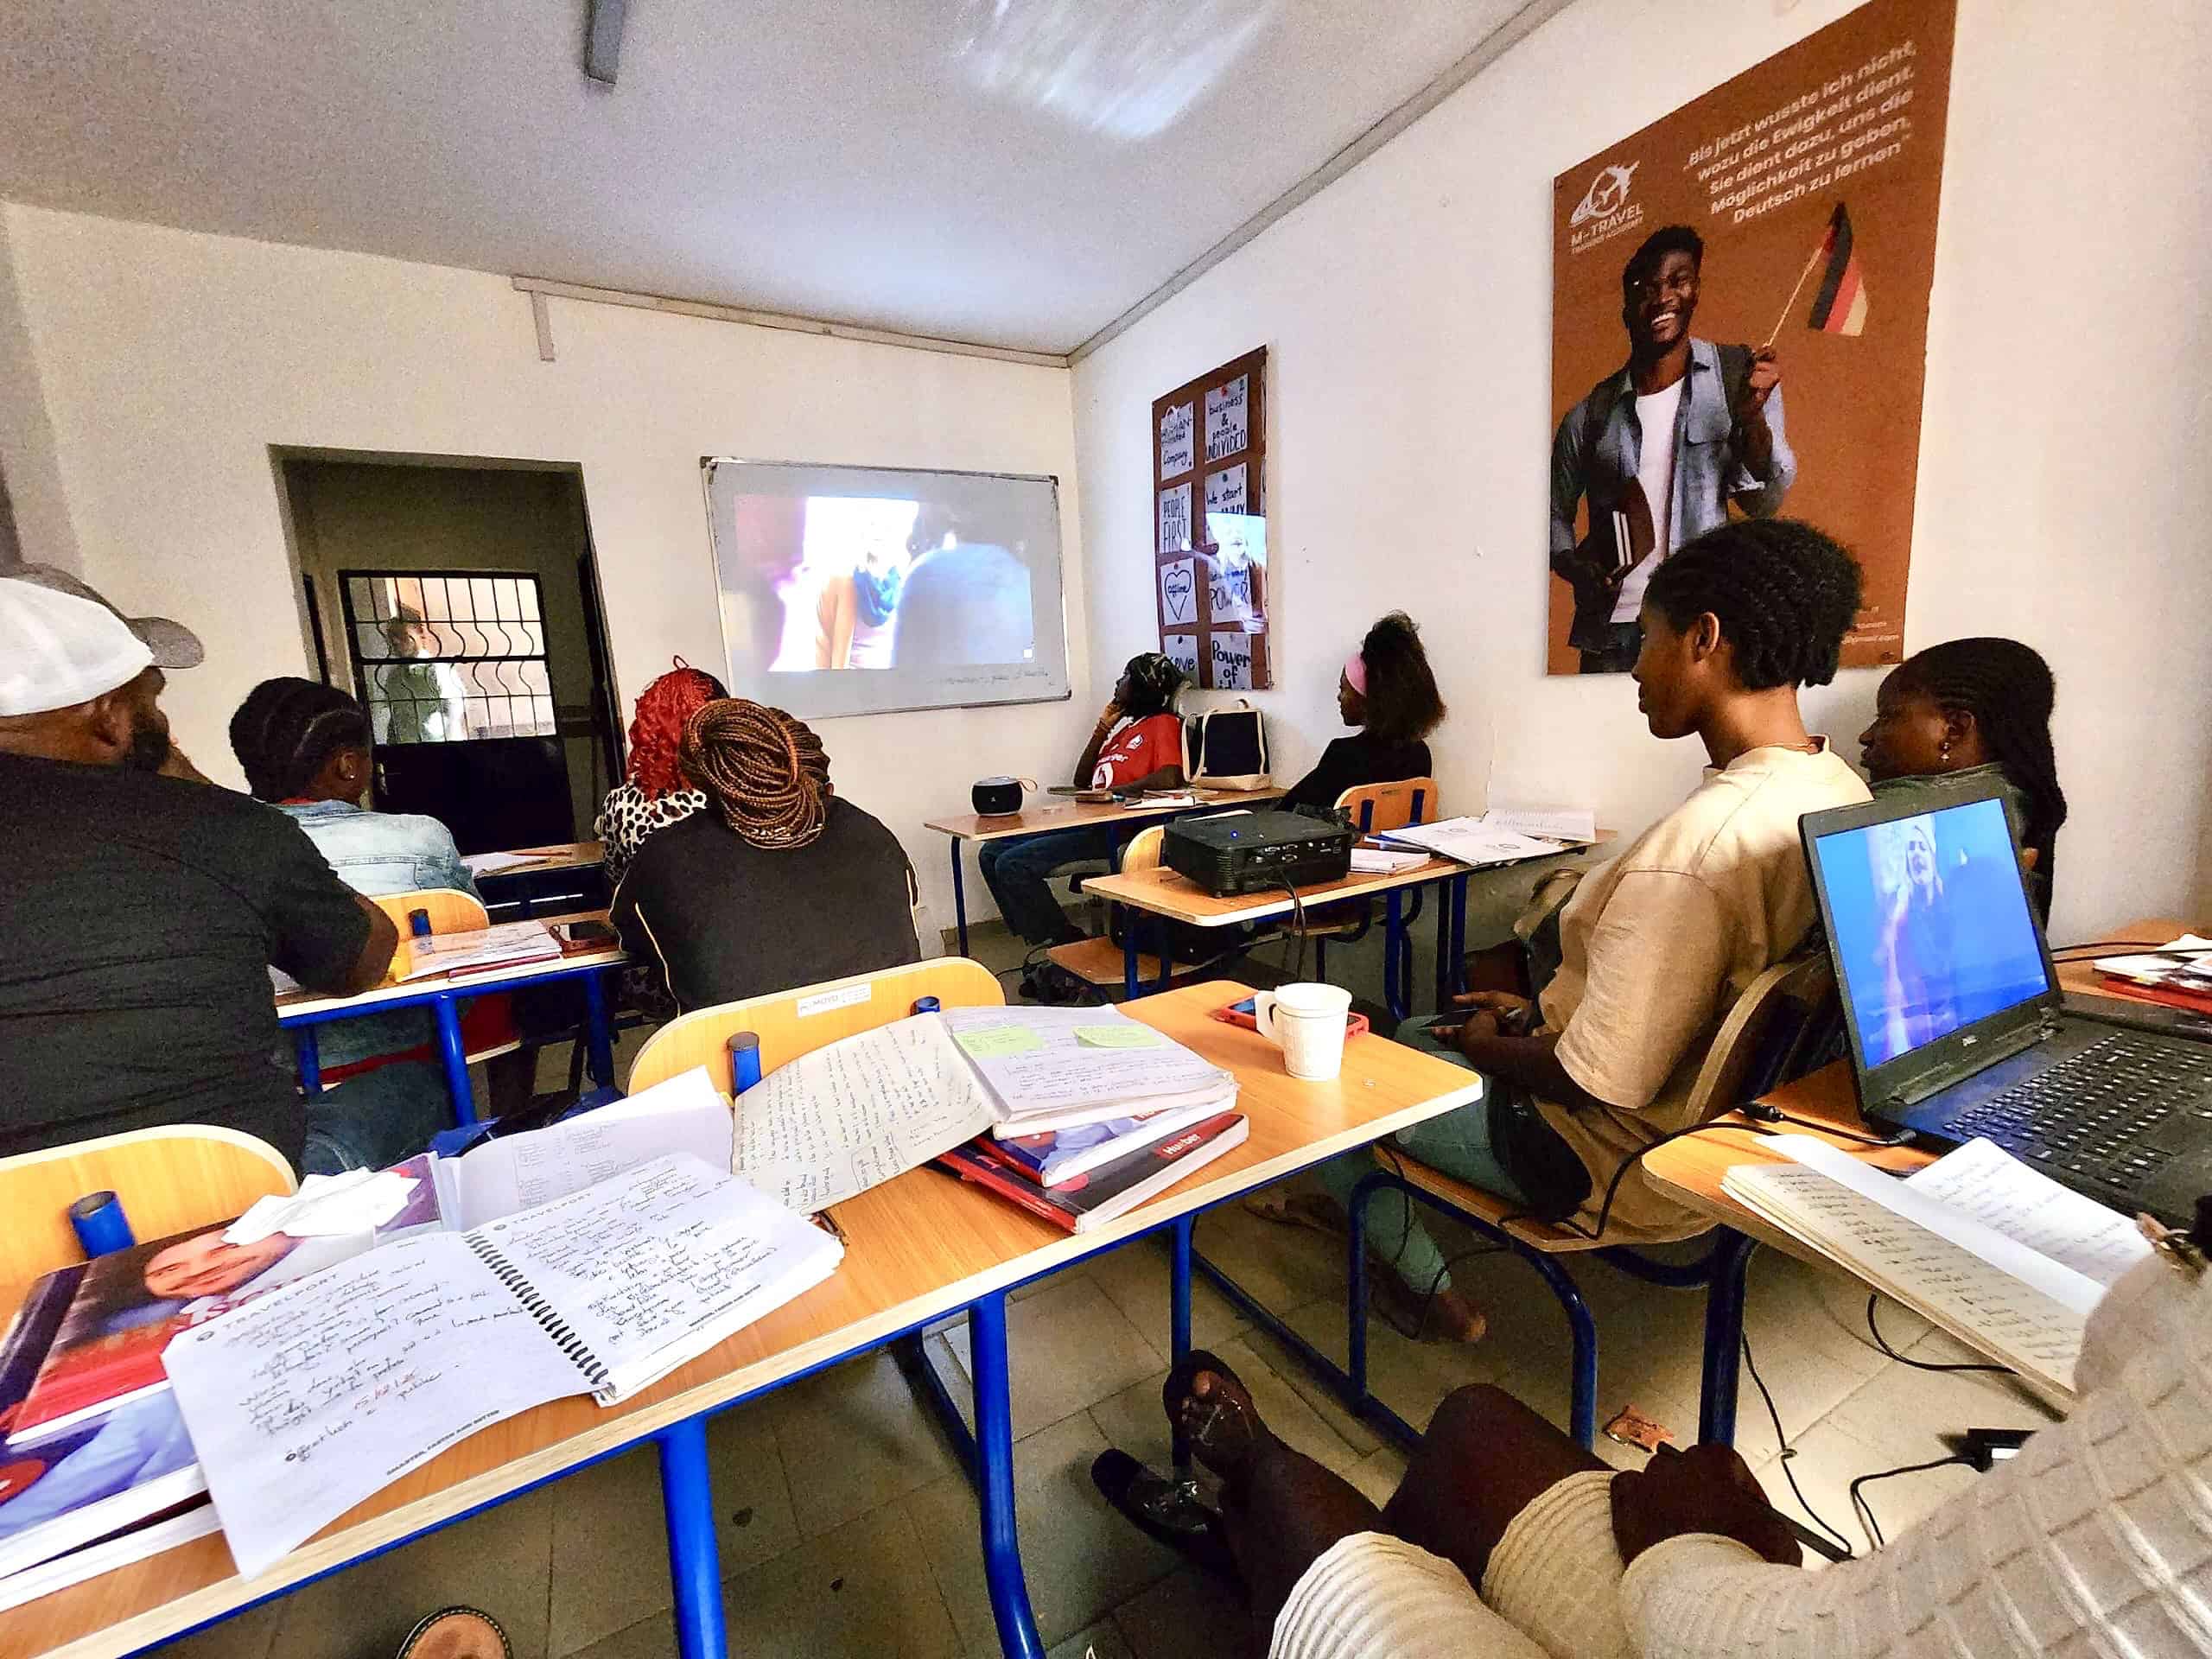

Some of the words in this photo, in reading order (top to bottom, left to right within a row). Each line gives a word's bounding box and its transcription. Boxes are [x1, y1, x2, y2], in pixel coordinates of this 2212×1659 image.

[1714, 124, 1751, 157] jetzt
[1754, 92, 1819, 132] wusste
[1823, 74, 1853, 98] ich
[1698, 151, 1739, 182] wozu
[1743, 139, 1770, 159] die
[1772, 95, 1852, 144] Ewigkeit
[1709, 175, 1733, 194] Sie
[1737, 152, 1782, 181] dient
[1839, 108, 1876, 133] uns
[1880, 89, 1914, 114] die
[1711, 158, 1812, 214] Möglichkeit
[1815, 148, 1837, 168] zu
[1734, 181, 1806, 223] Deutsch
[1809, 173, 1831, 192] zu
[1163, 496, 1185, 518] PEOPLE
[1222, 483, 1243, 501] start
[1163, 518, 1186, 552] FIRST
[1212, 640, 1251, 668] Power
[1223, 665, 1238, 684] of
[512, 1192, 591, 1224] TRAVELPORT
[222, 1274, 337, 1328] TRAVELPORT
